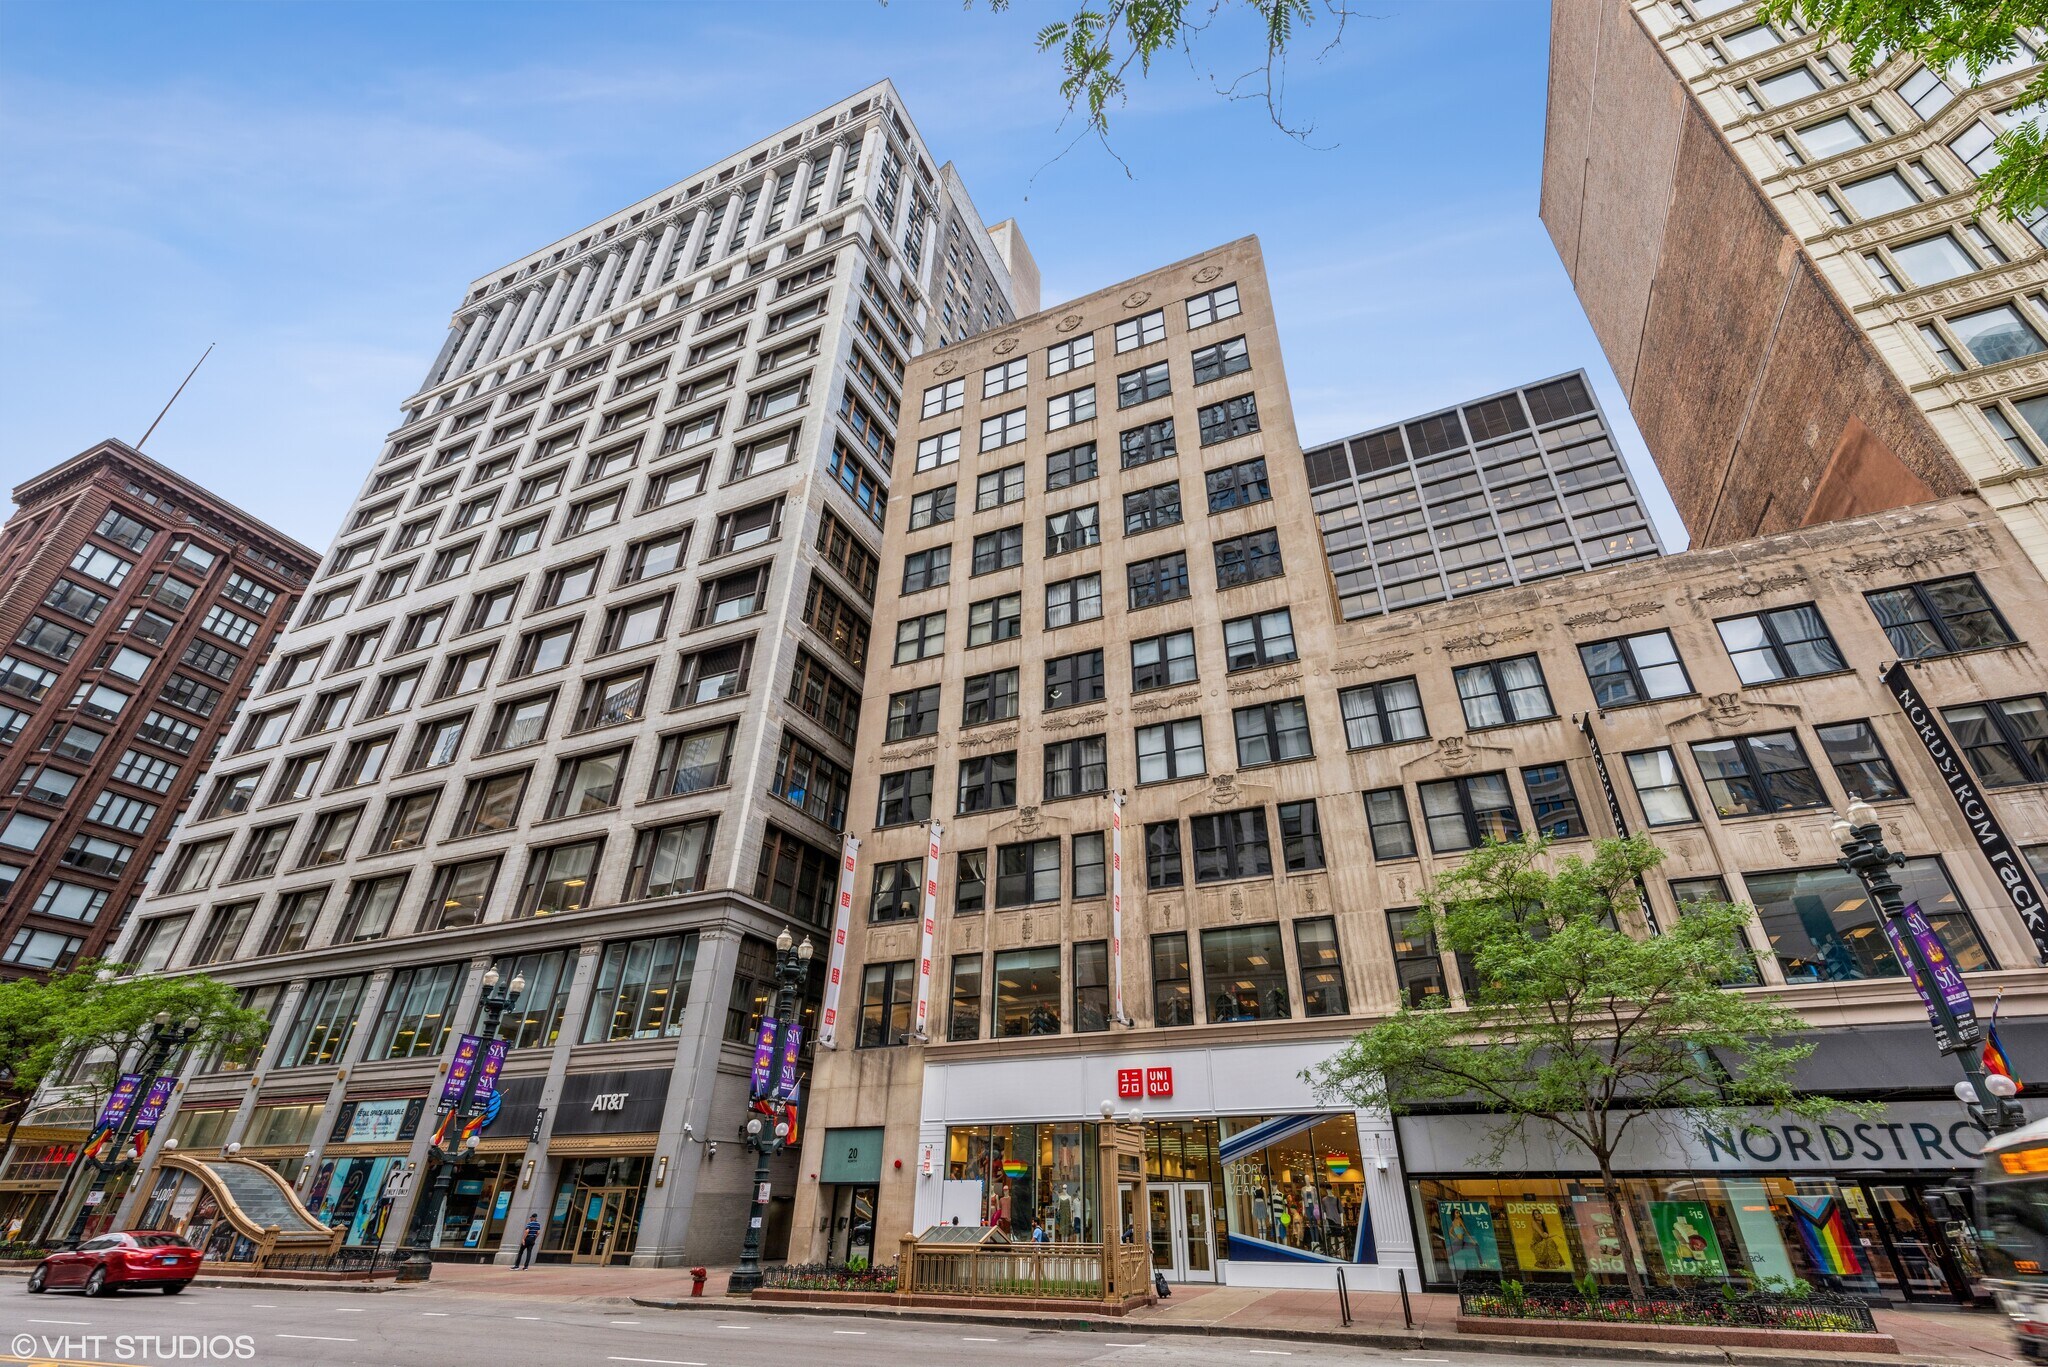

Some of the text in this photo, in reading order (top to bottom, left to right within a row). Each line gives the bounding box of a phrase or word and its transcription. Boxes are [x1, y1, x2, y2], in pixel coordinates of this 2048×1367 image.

[1991, 850, 2046, 932] rack
[1150, 1070, 1167, 1081] UNI
[1150, 1081, 1170, 1094] QLO
[590, 1093, 629, 1111] AT&T
[532, 1111, 543, 1140] AT&T
[848, 1148, 858, 1159] 20
[1230, 1163, 1264, 1175] SPORT
[1506, 1203, 1559, 1214] DRESSES
[1689, 1210, 1704, 1219] $15
[1477, 1221, 1489, 1229] $13
[1513, 1220, 1526, 1229] $35
[1590, 1257, 1644, 1272] SHOS
